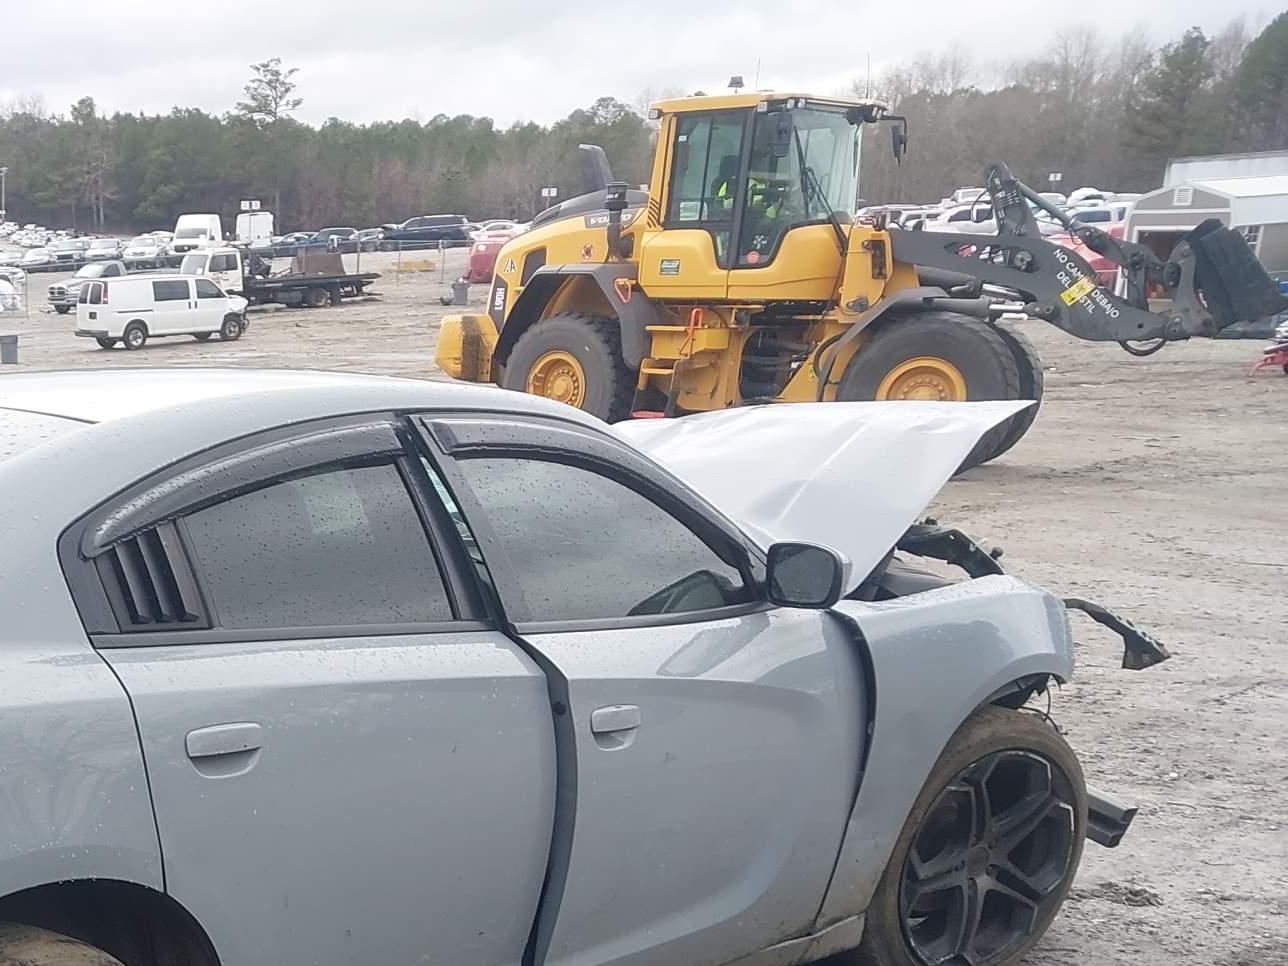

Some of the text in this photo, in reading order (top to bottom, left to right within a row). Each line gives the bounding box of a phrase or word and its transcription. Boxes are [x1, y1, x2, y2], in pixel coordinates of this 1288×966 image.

[591, 213, 632, 225] VOO
[1053, 248, 1067, 263] NO
[1091, 290, 1120, 319] DEBAJO
[1057, 272, 1072, 288] DEL
